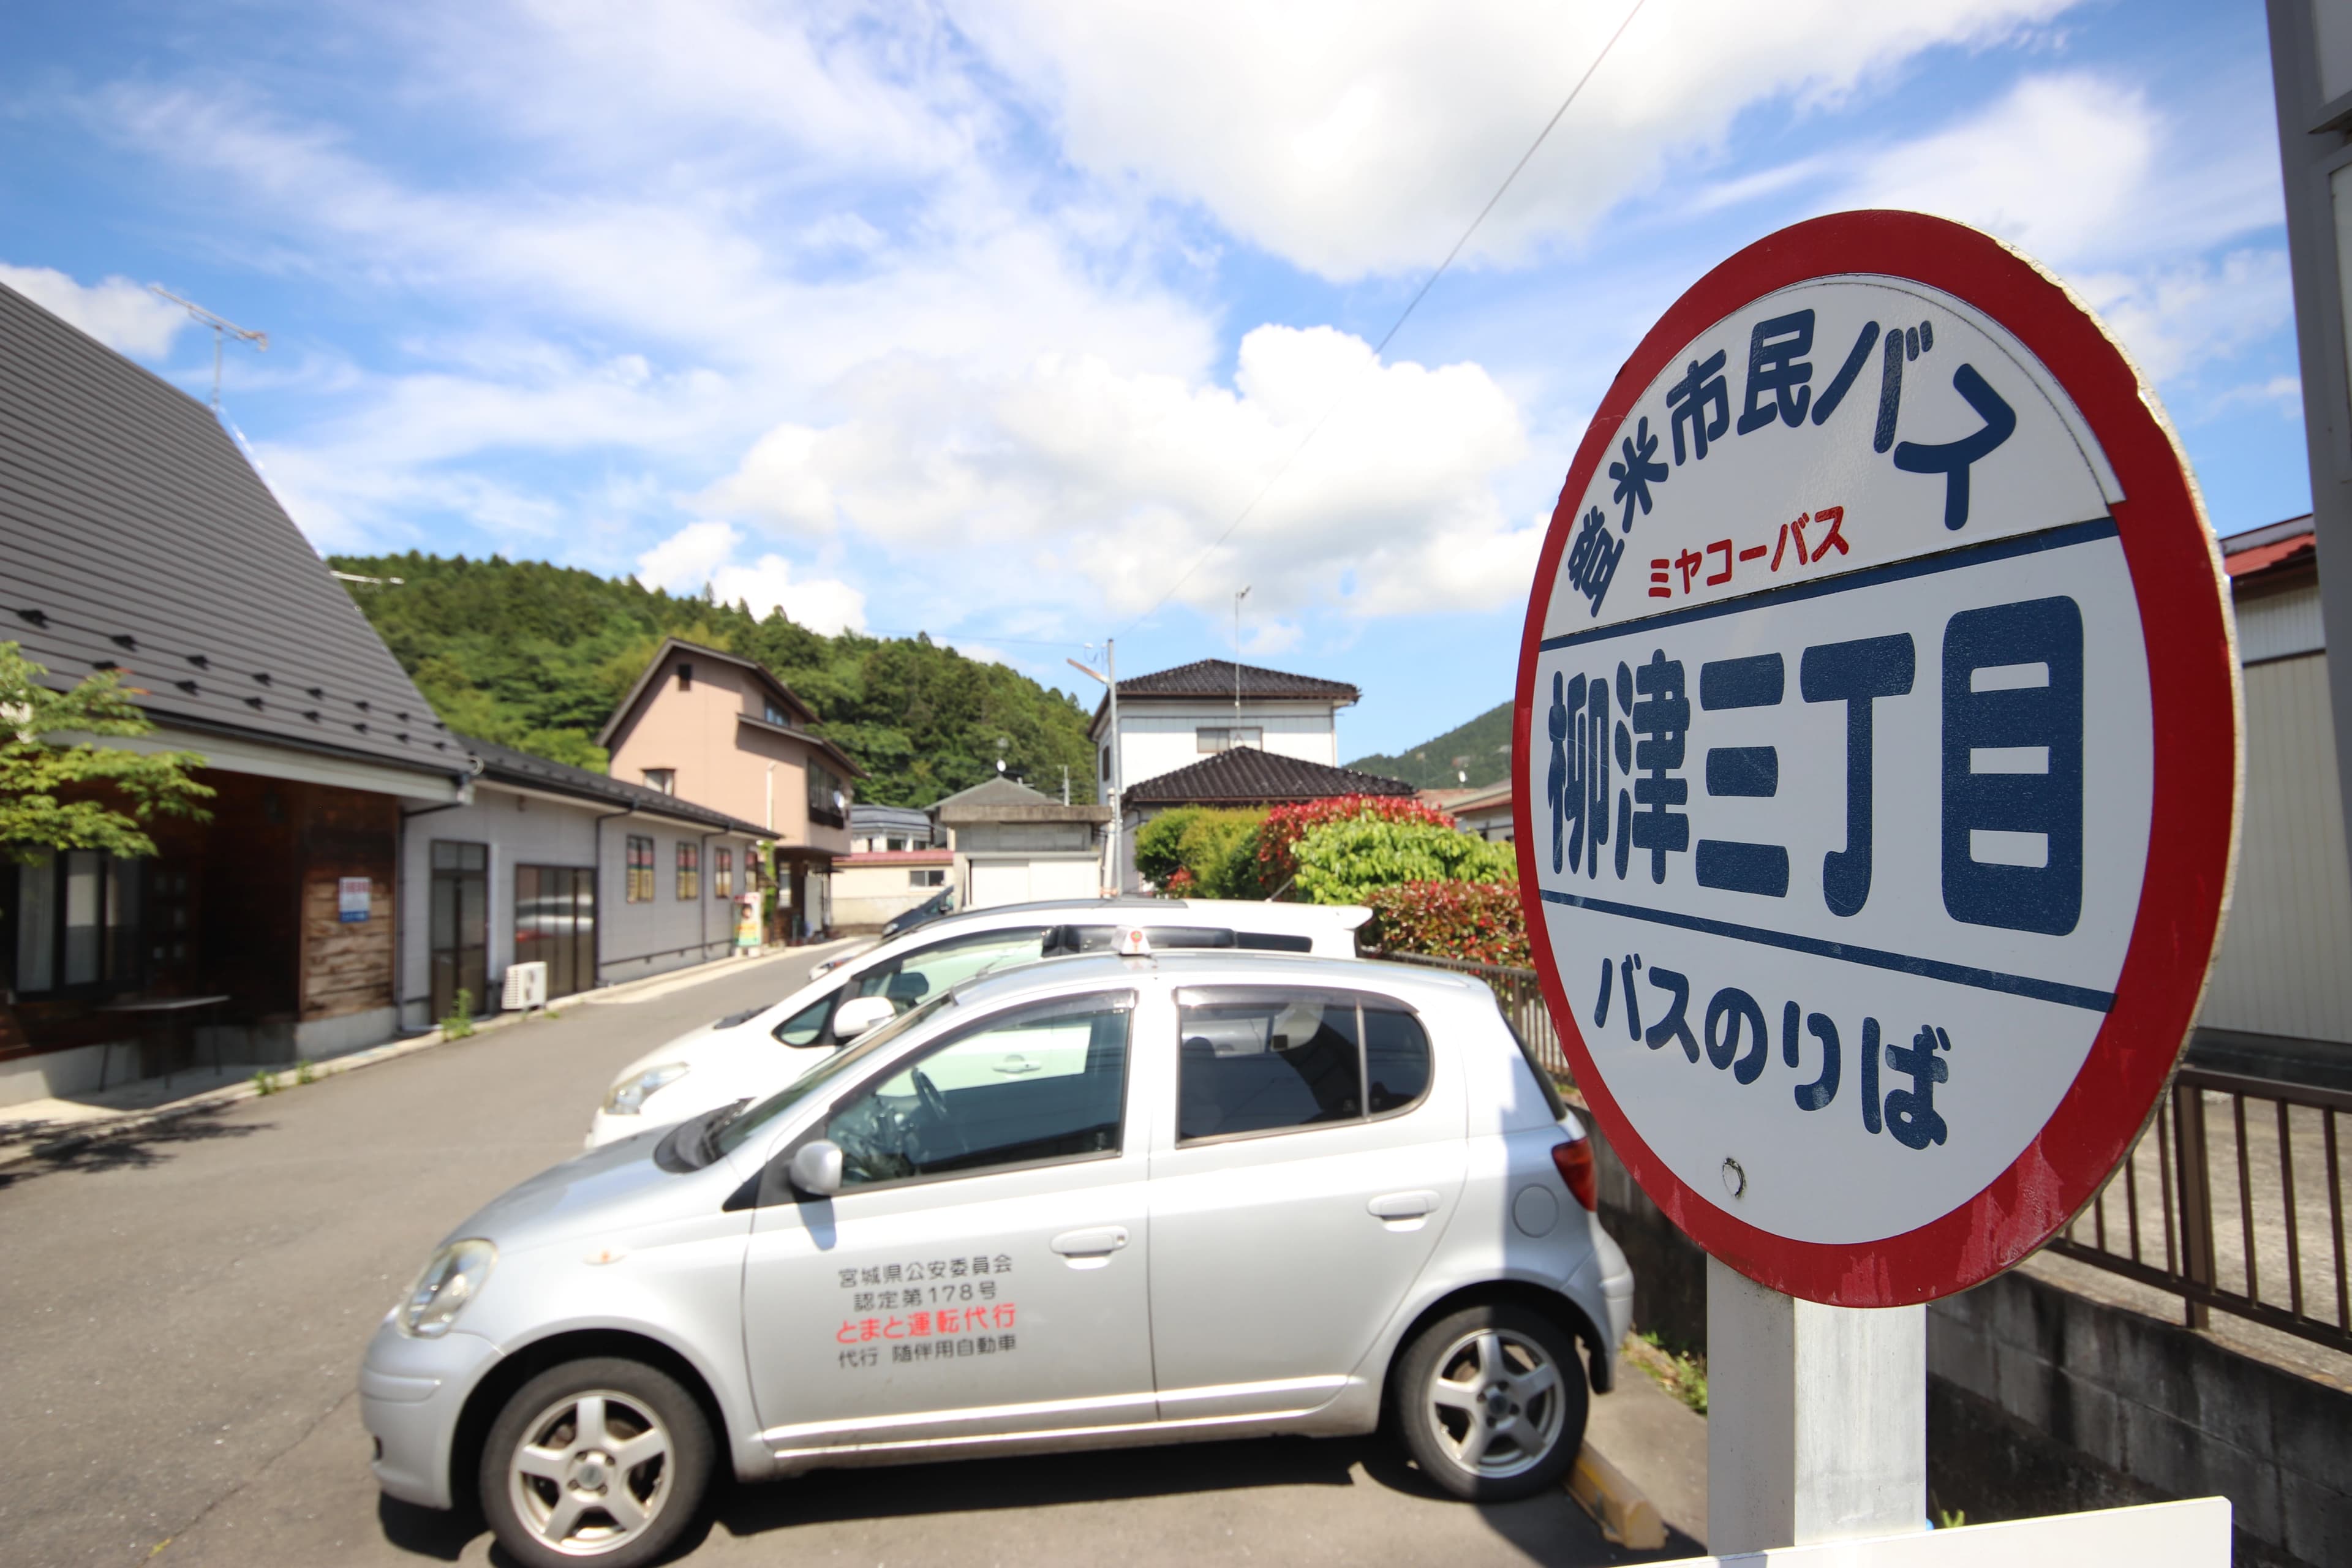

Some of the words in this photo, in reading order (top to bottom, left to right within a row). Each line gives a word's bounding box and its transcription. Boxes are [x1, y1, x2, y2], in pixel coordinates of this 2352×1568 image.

[1568, 308, 2016, 617] 登米市民バス
[1648, 506, 1849, 598] ミヤコーバス
[1548, 595, 2083, 936] 柳津三丁目
[1594, 953, 1951, 1150] バスのりば
[839, 1254, 1012, 1288] 宮城県公安委員会
[854, 1281, 997, 1311] 認定第178号
[837, 1303, 1016, 1344] とまと運転代行
[838, 1347, 878, 1368] 代行
